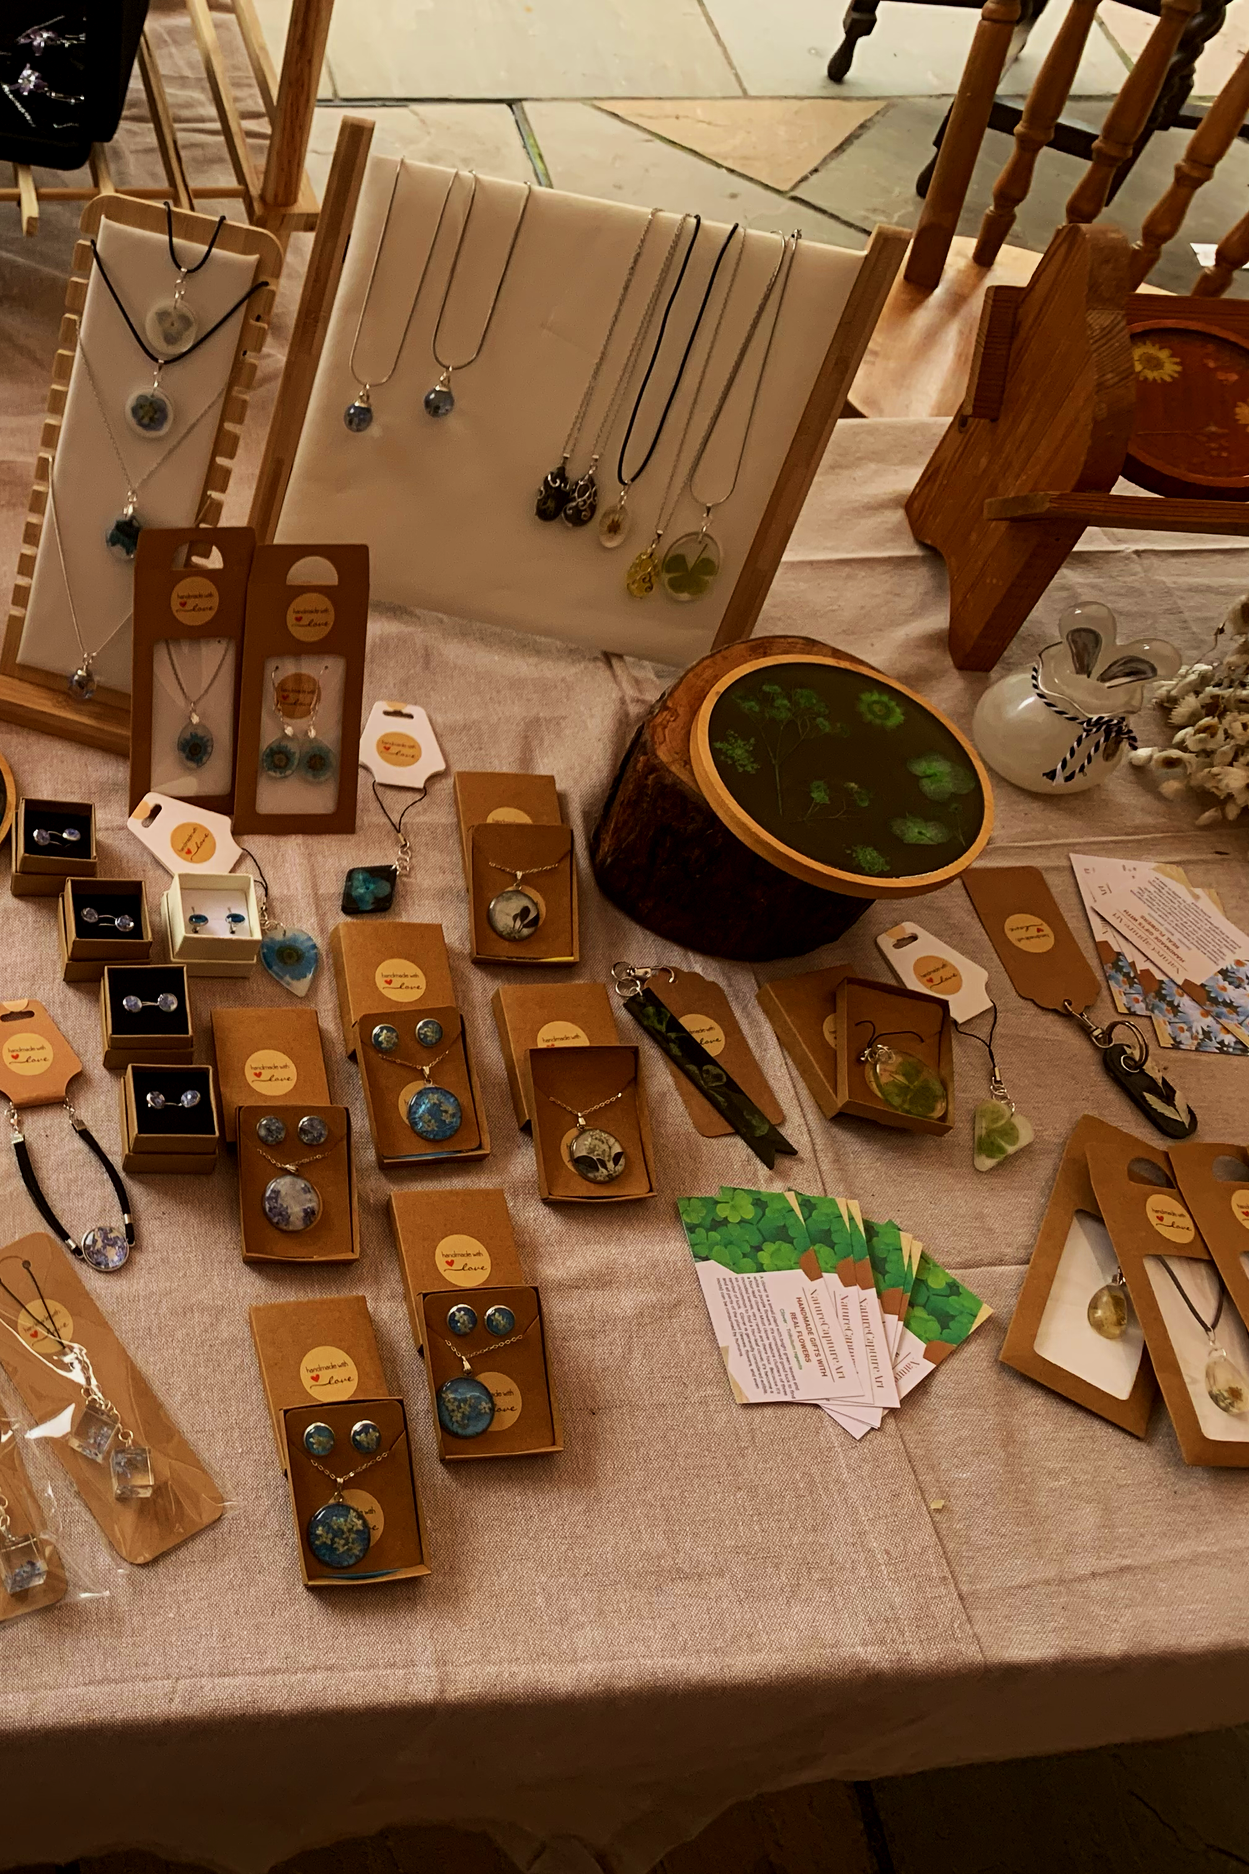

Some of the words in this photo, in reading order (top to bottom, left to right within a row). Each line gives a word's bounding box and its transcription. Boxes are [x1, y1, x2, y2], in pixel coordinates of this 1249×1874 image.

[1122, 908, 1138, 922] WITH
[1137, 921, 1154, 936] GIFTS
[1139, 914, 1165, 937] FLOWERS
[1111, 911, 1182, 974] NatureCaptureArt
[1153, 934, 1185, 962] HANDMADE
[1165, 936, 1180, 949] REAL
[542, 1034, 571, 1043] handmade
[9, 1056, 50, 1064] love
[252, 1074, 292, 1082] love
[1156, 1221, 1192, 1232] love
[444, 1262, 487, 1272] love
[786, 1328, 796, 1350] Trifolium
[789, 1312, 800, 1329] REAL
[795, 1330, 811, 1362] FLOWERS
[795, 1297, 813, 1335] HANDMADE
[809, 1337, 821, 1356] GIFTS
[816, 1358, 827, 1376] WITH
[808, 1289, 847, 1378] NatureCaptureArt
[858, 1298, 885, 1389] NatureCaptureArt
[306, 1364, 336, 1373] handmade
[310, 1375, 354, 1389] love
[502, 1388, 514, 1396] with
[364, 1507, 376, 1516] with
